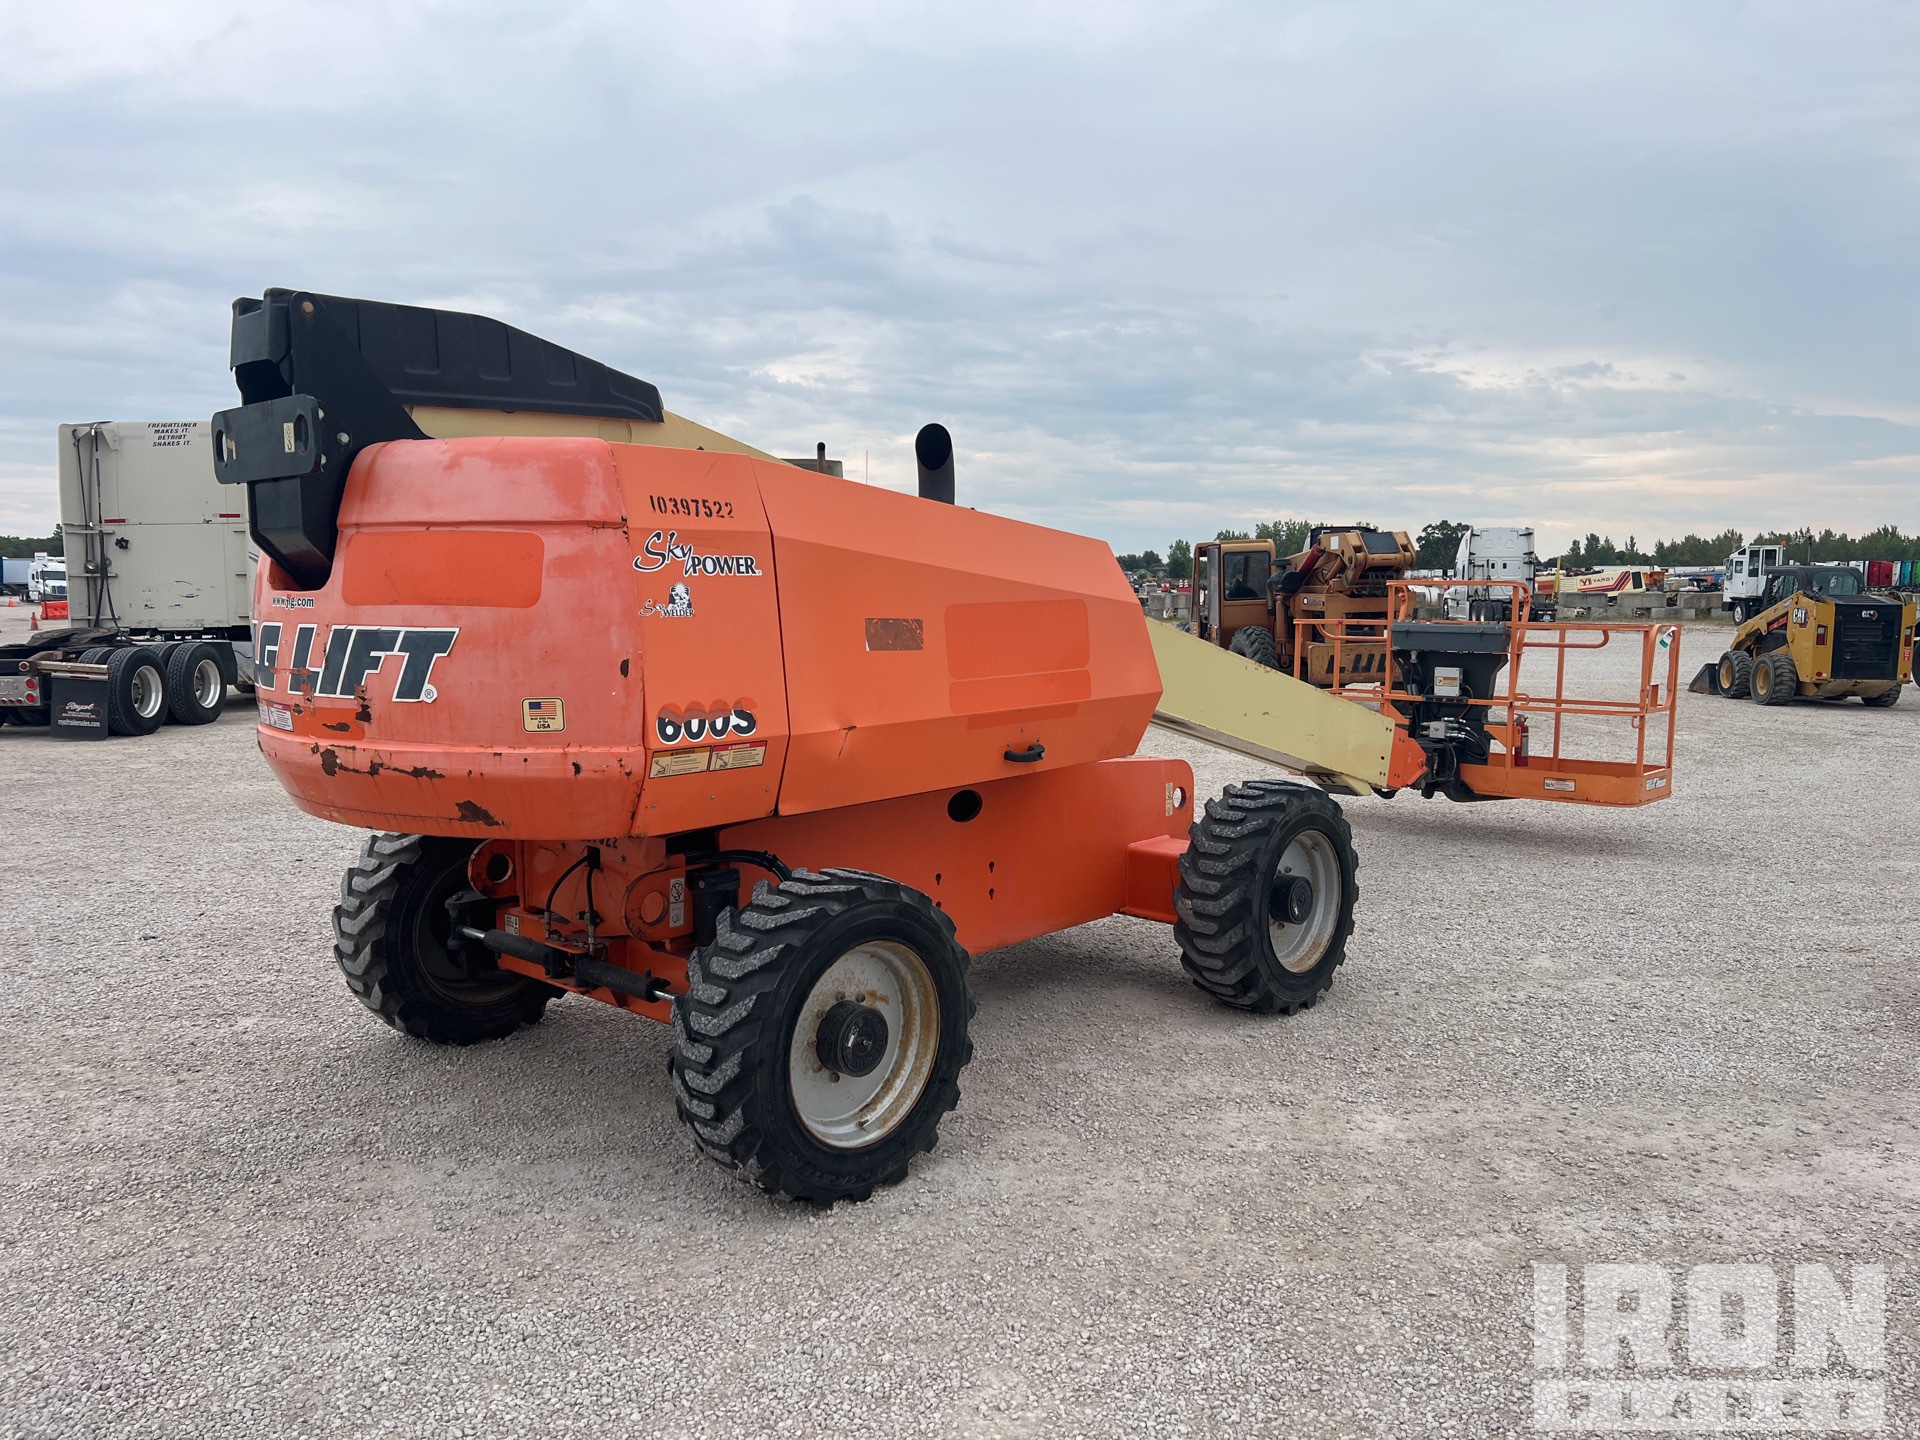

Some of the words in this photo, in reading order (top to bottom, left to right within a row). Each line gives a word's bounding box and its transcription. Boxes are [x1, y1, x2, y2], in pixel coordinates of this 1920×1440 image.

[648, 494, 735, 519] 10397522
[661, 608, 694, 617] WELDER
[1793, 607, 1806, 624] CAT
[287, 623, 460, 703] LIFT
[65, 701, 95, 711] Royal
